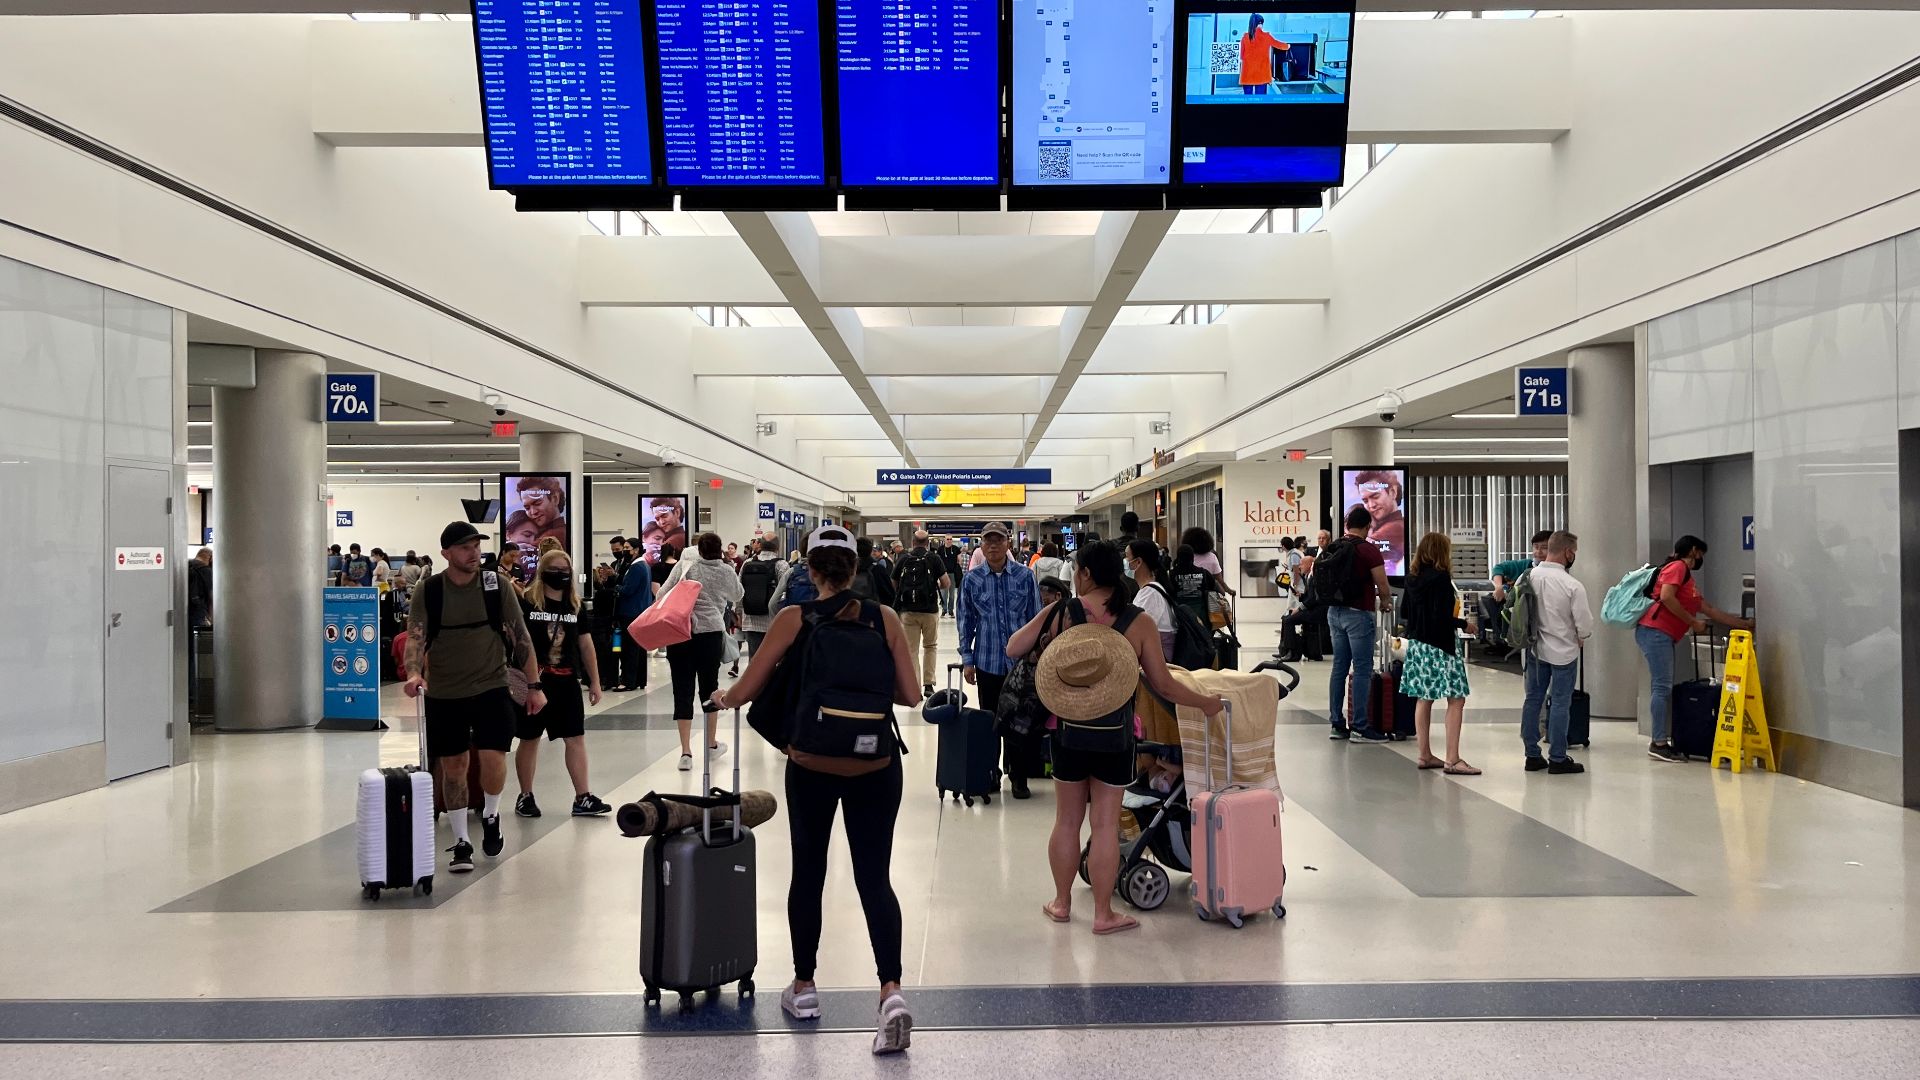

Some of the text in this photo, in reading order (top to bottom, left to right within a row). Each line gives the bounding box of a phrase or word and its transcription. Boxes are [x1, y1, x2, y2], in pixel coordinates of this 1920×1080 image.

[1524, 376, 1550, 386] Gate
[330, 382, 356, 392] Gate
[1524, 389, 1561, 407] 71B
[330, 395, 368, 414] 70A
[1244, 501, 1310, 522] klatch
[1252, 526, 1300, 535] COFFEE
[530, 612, 551, 620] SYSTEM
